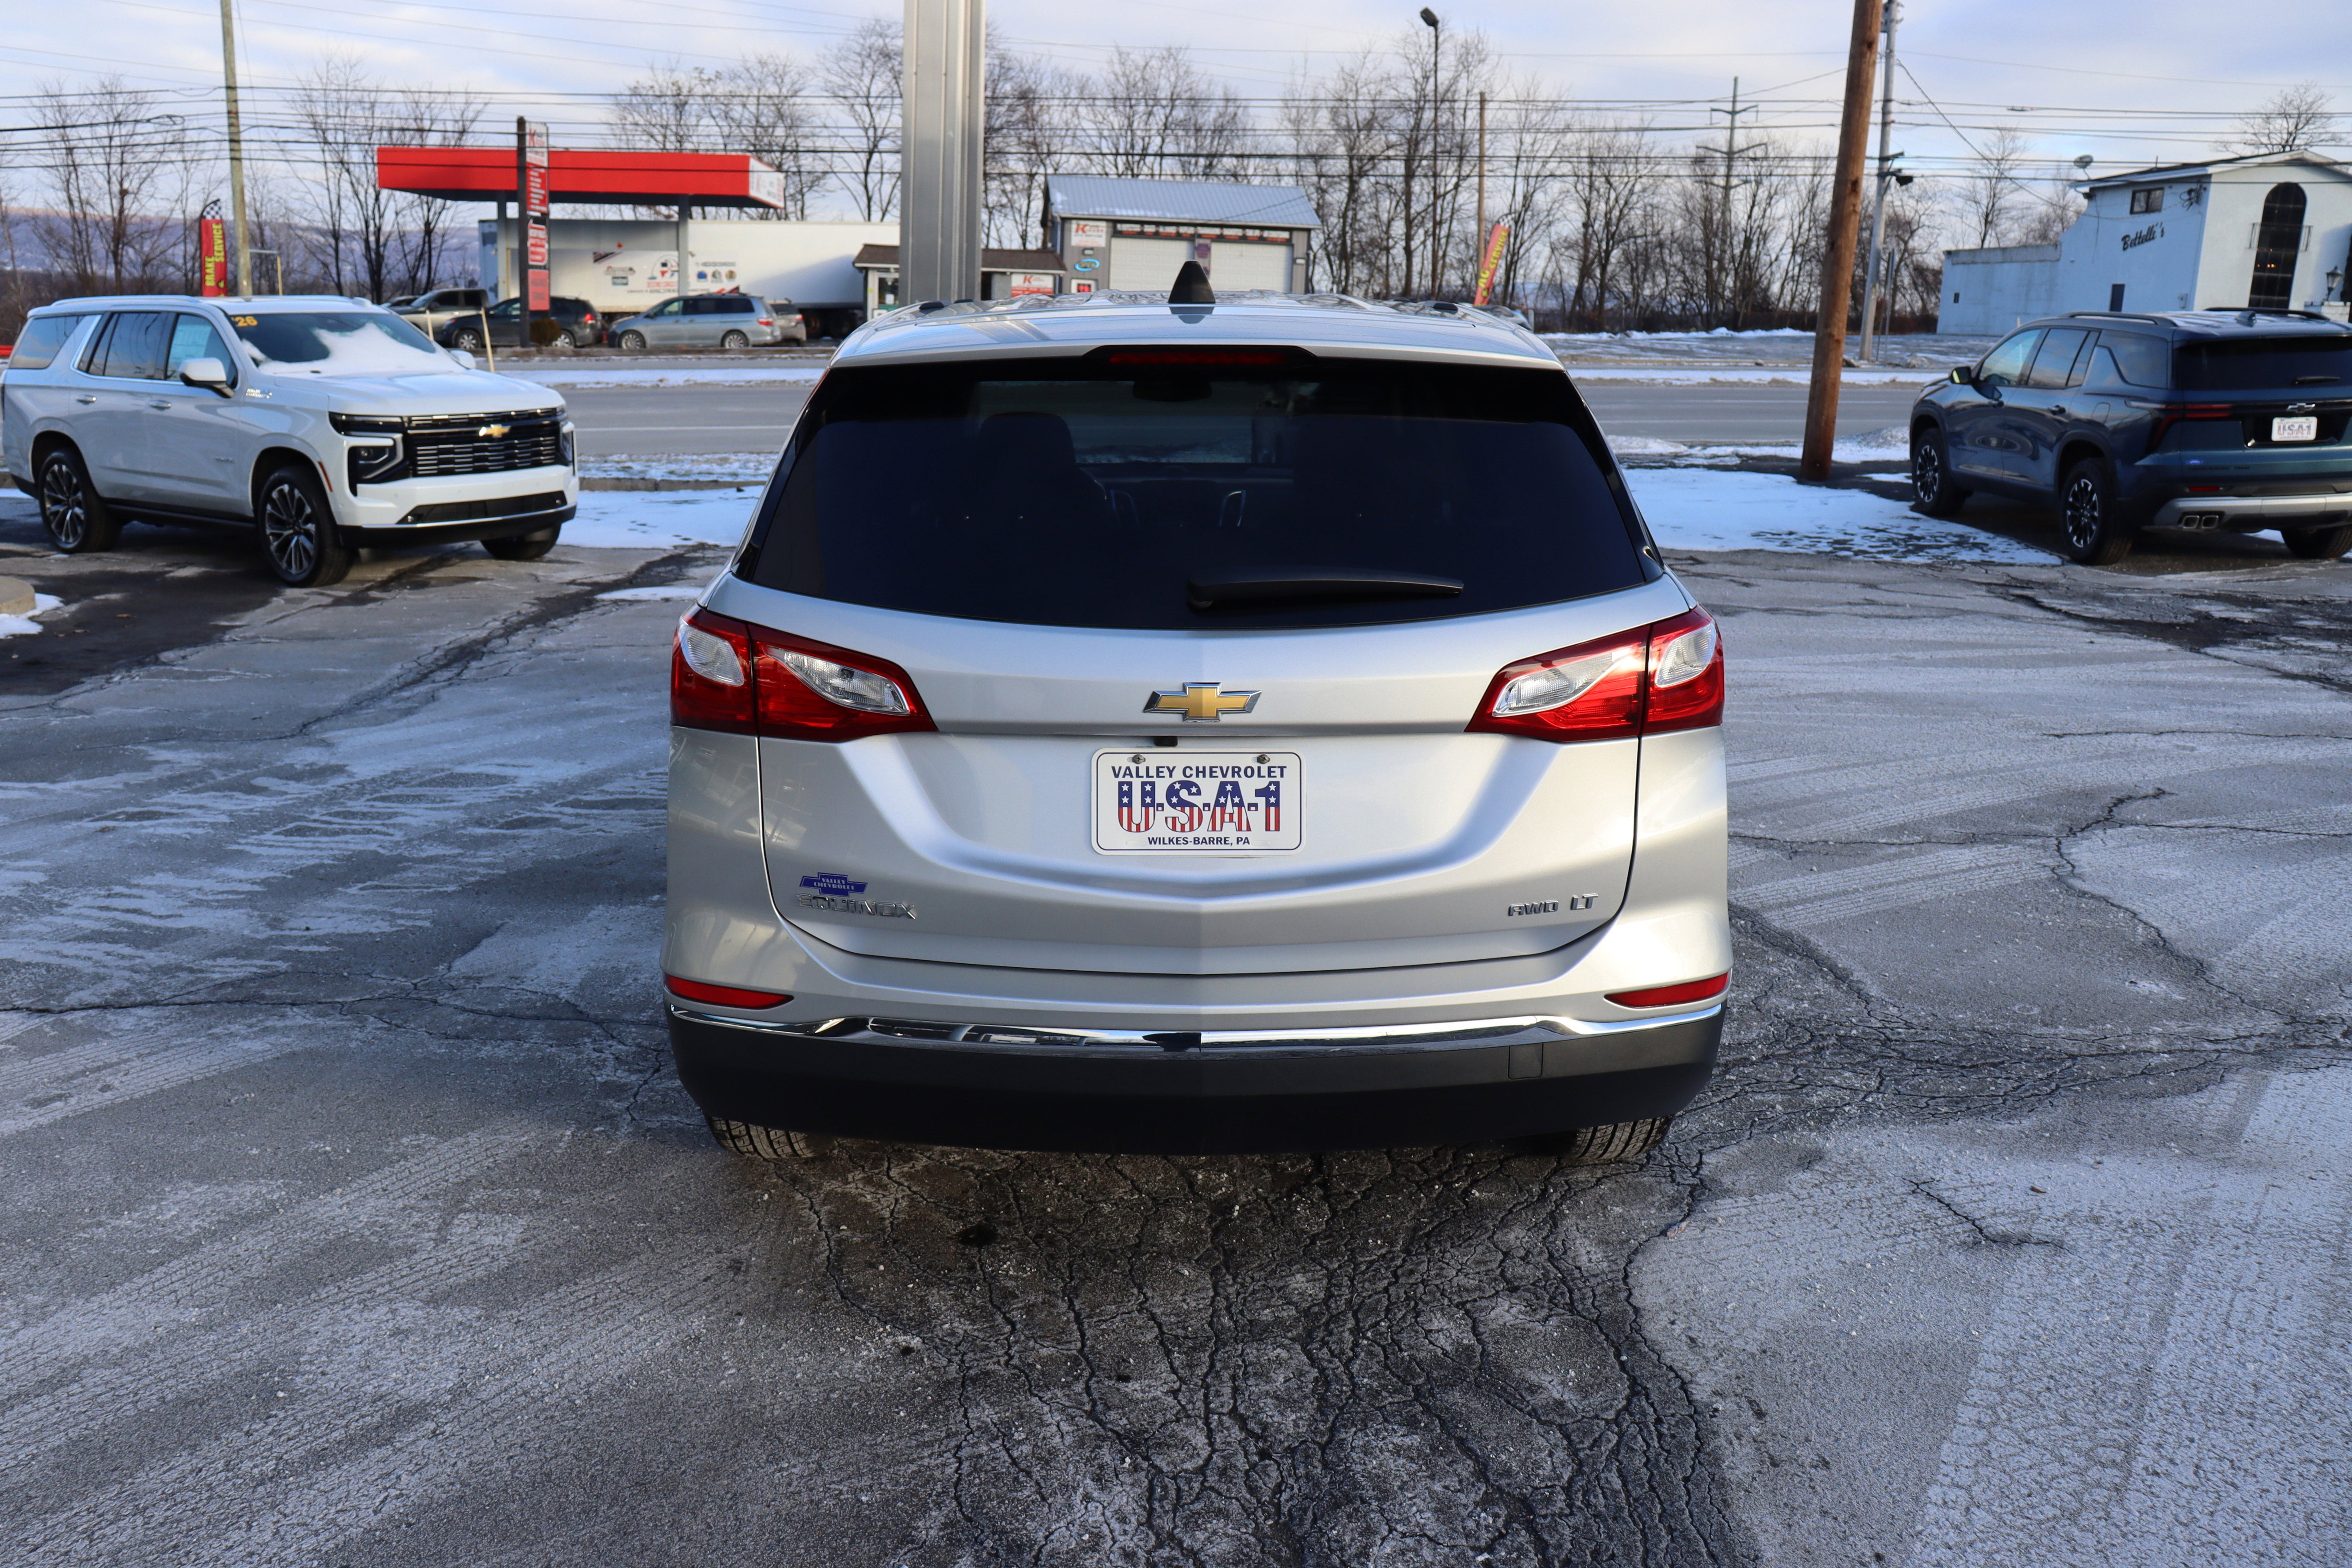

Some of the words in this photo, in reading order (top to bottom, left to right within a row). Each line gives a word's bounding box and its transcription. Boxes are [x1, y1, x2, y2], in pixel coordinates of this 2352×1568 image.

[212, 223, 225, 262] SERVICE
[1489, 229, 1508, 269] SERVICE
[205, 256, 216, 286] BRAKE
[1478, 269, 1491, 288] AC
[231, 316, 258, 327] '26
[1111, 766, 1176, 778] VALLEY
[1182, 766, 1287, 779] CHEVROLET
[1147, 836, 1233, 847] WILKES-BARRE,
[1236, 837, 1250, 845] PA
[813, 882, 855, 891] CHEVROLET
[795, 892, 918, 920] EQUINOX
[1508, 899, 1559, 917] AWD
[1570, 893, 1599, 911] LT
